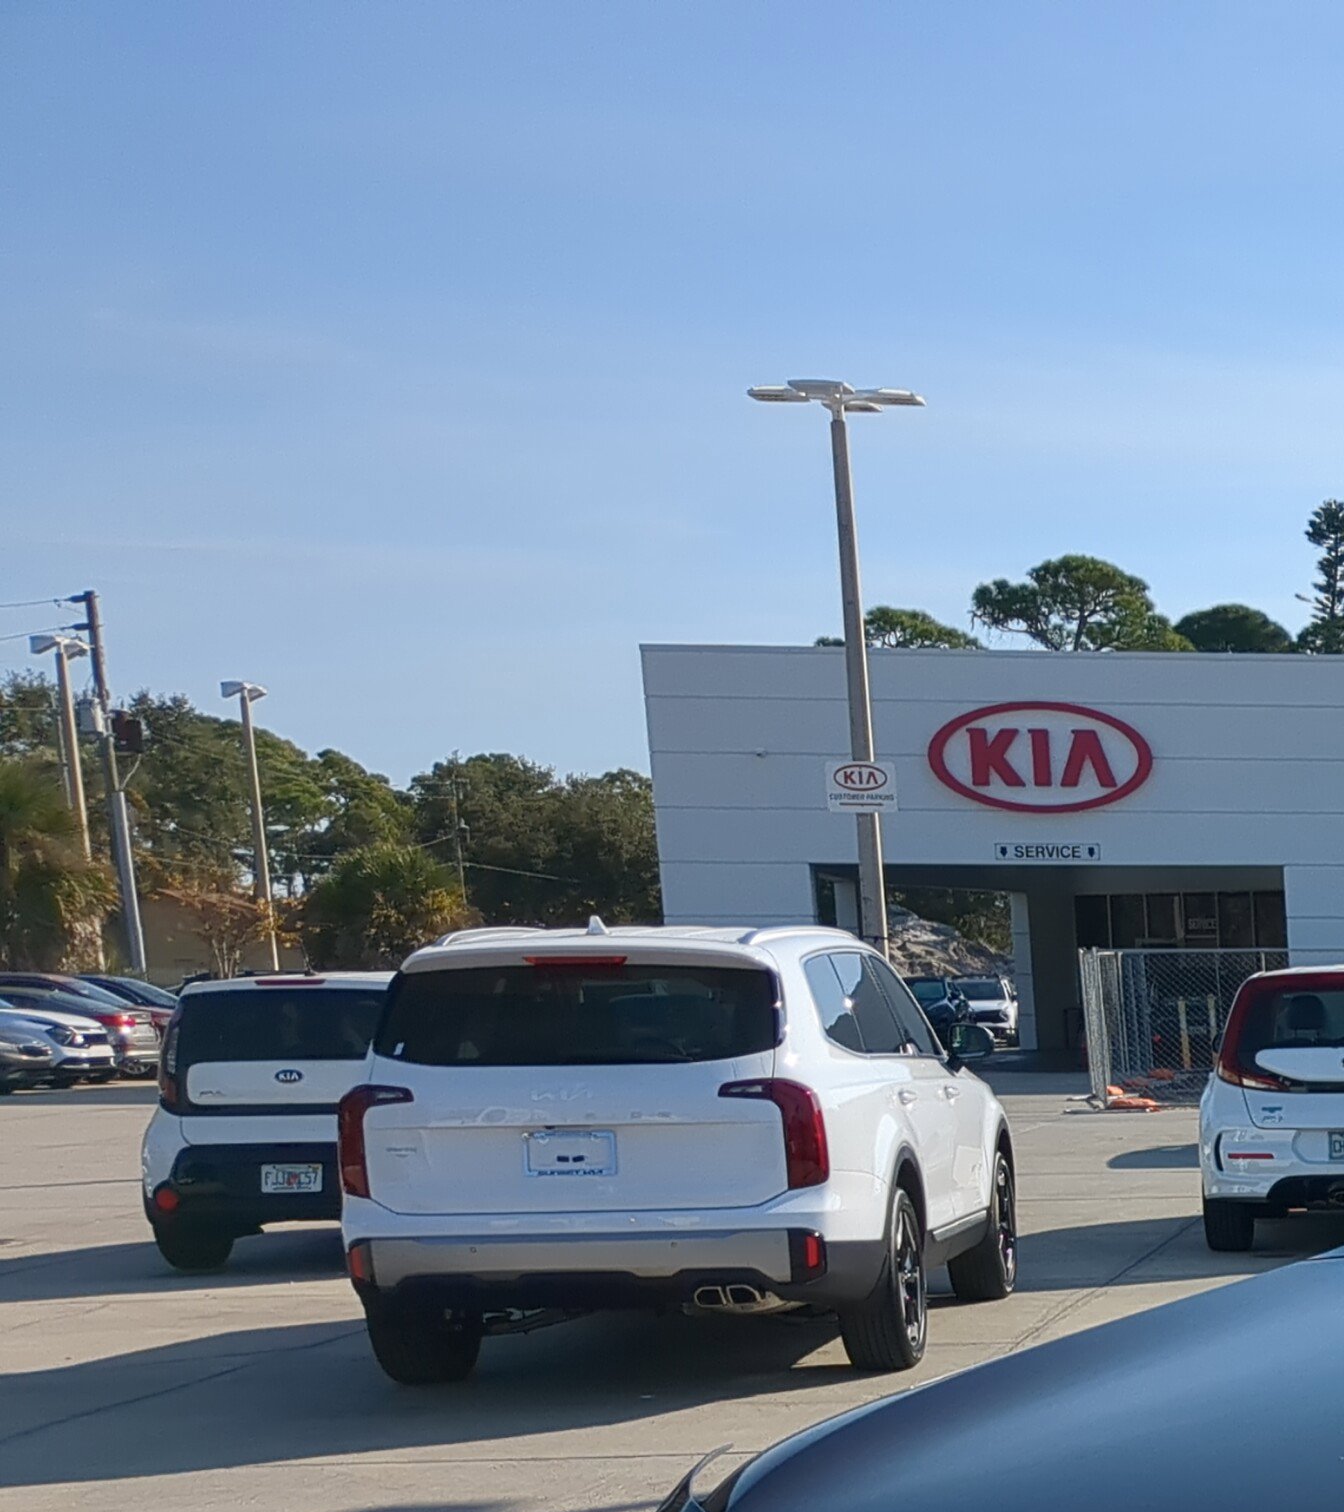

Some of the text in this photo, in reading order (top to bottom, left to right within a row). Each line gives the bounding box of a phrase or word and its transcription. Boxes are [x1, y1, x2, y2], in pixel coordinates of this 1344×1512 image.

[966, 728, 1118, 788] KIA
[843, 770, 878, 785] KIA
[1014, 844, 1082, 860] SERVICE
[278, 1071, 300, 1081] KIA
